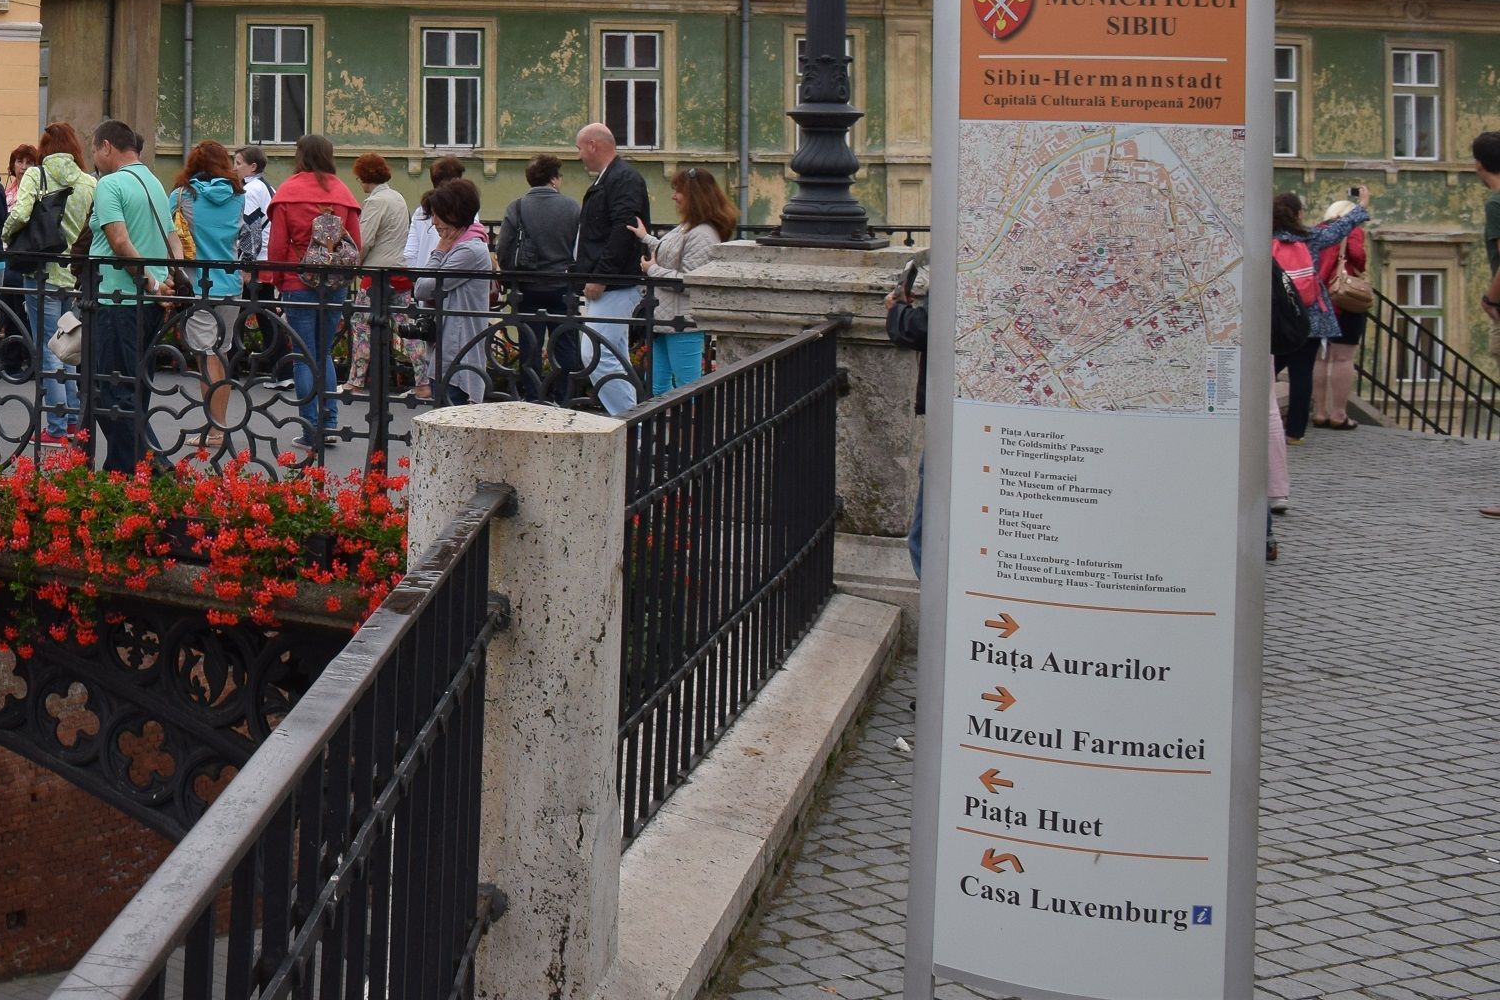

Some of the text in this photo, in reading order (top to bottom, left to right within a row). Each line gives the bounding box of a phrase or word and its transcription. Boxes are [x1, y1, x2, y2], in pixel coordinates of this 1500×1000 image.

[1106, 16, 1178, 37] SIBIU
[984, 69, 1222, 89] Sibiu-Hermannstadt
[983, 93, 1222, 110] Capitală Culturală Europeană 2007
[1024, 430, 1065, 440] Aurarilor
[1000, 438, 1016, 446] The
[1070, 444, 1104, 454] Passage
[1000, 448, 1085, 463] Der Fingerlingsplatz
[1000, 468, 1077, 482] Muzeul Farmaciei
[1000, 478, 1016, 486] The
[1018, 480, 1054, 490] Museum
[1069, 484, 1113, 496] Pharmacy
[1000, 489, 1098, 504] Das Apothekenmuseum
[1022, 510, 1043, 519] Huet
[998, 518, 1051, 530] Huet Square
[998, 529, 1059, 542] Der Huet Platz
[997, 550, 1017, 559] Casa
[1020, 553, 1070, 566] Luxemburg
[1076, 558, 1123, 569] Infoturism
[997, 561, 1013, 569] The
[1015, 563, 1041, 573] House
[1043, 566, 1053, 574] of
[1054, 567, 1105, 580] Luxemburg
[1112, 571, 1143, 581] Tourist
[1146, 573, 1163, 582] Info
[997, 571, 1011, 579] Das
[1014, 573, 1063, 586] Luxemburg
[1066, 579, 1088, 588] Haus
[1095, 581, 1186, 593] Touristeninformation
[1040, 651, 1171, 681] Aurarilor
[966, 714, 1206, 760] Muzeul Farmaciei
[1037, 808, 1104, 837] Huet
[959, 875, 1021, 906] Casa
[1029, 887, 1188, 932] Luxemburg
